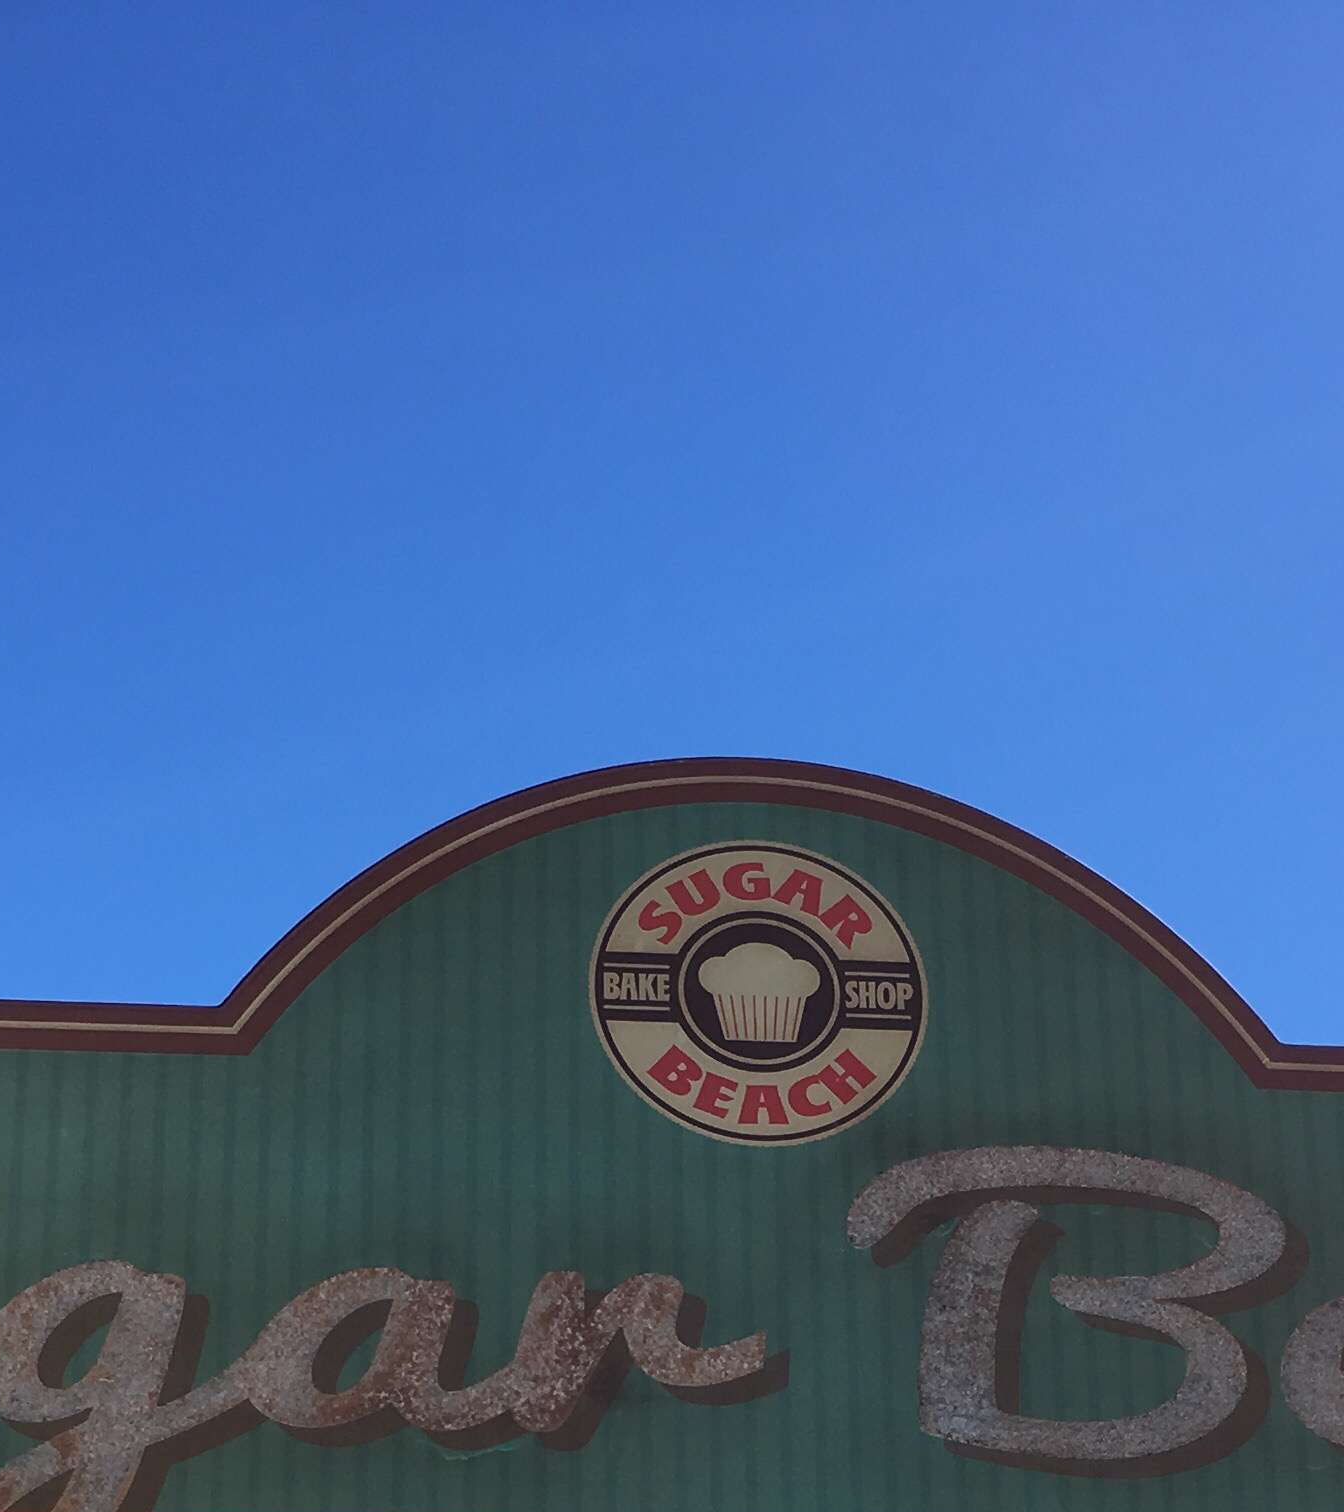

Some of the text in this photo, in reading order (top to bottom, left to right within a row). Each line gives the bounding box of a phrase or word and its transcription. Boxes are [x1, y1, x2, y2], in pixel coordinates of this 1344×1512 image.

[637, 862, 873, 950] SUGAR
[603, 972, 914, 1010] BAKE SHOP
[645, 1044, 877, 1125] BEACH
